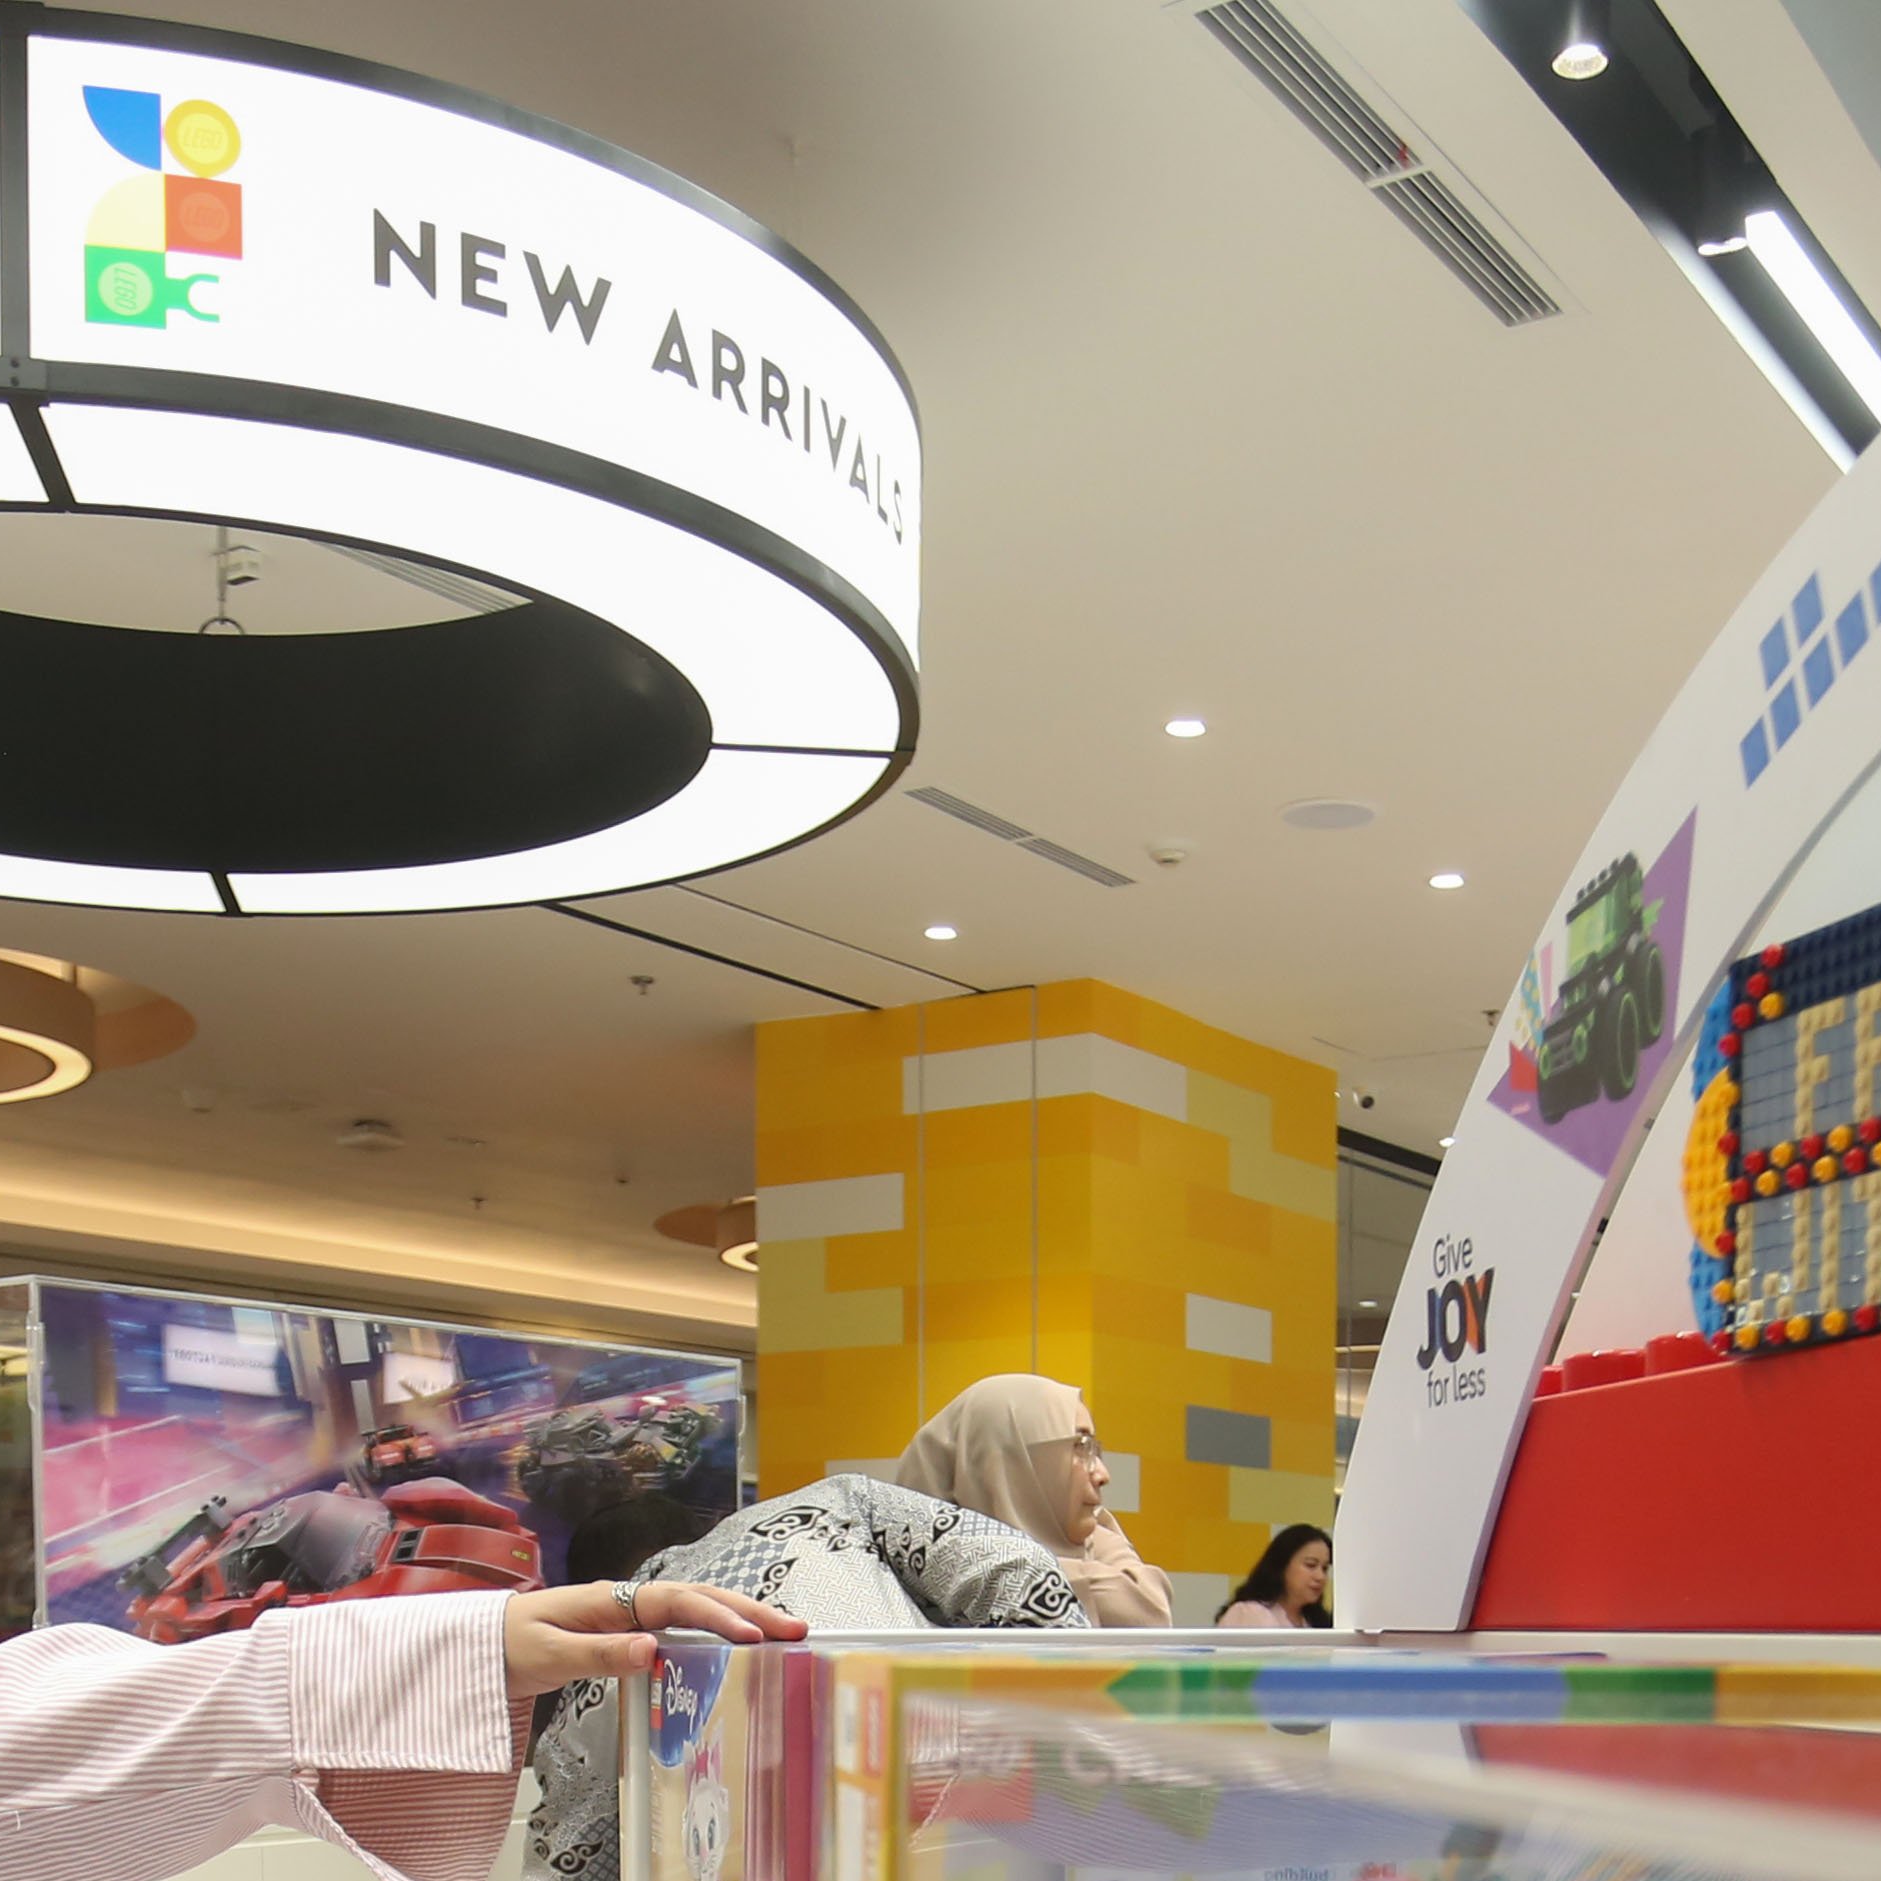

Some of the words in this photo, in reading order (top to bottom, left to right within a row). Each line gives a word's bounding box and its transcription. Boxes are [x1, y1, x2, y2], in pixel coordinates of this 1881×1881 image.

[373, 208, 612, 345] NEW
[651, 308, 904, 545] ARRIVALS
[1433, 1233, 1473, 1279] Give
[1417, 1266, 1495, 1371] JOY
[1427, 1371, 1450, 1408] for
[1453, 1362, 1486, 1402] less
[663, 1658, 698, 1736] Disney
